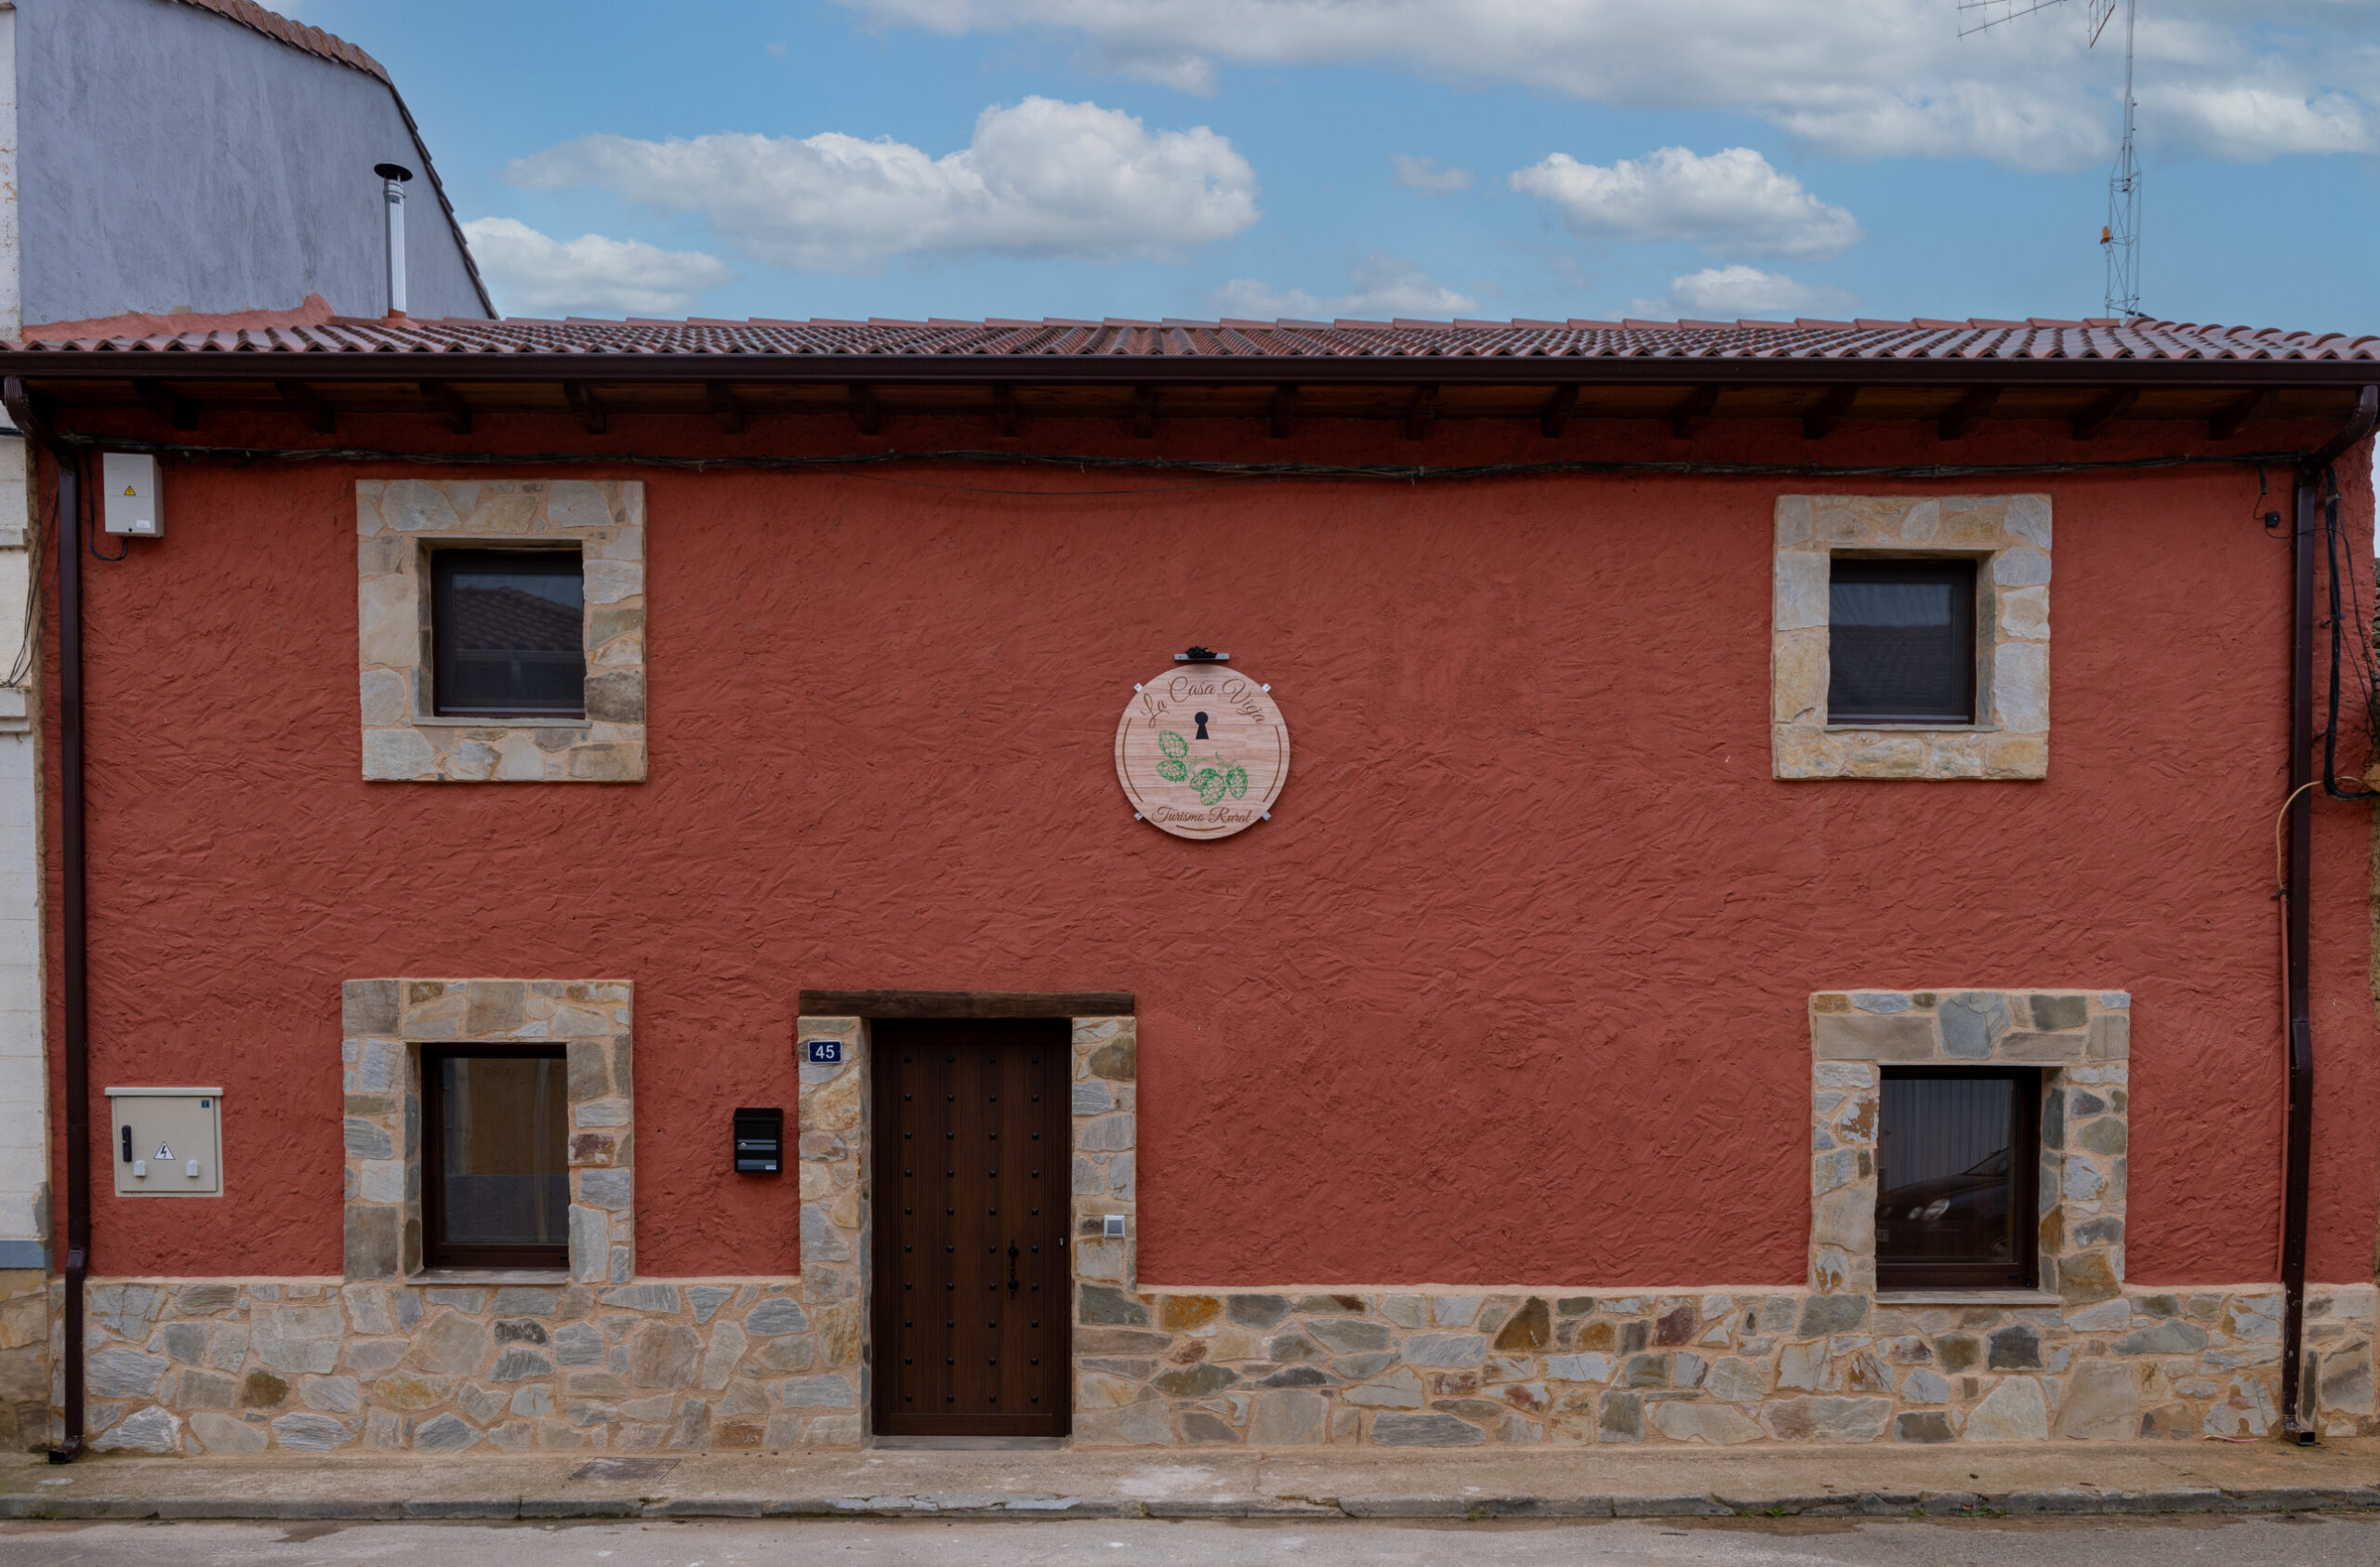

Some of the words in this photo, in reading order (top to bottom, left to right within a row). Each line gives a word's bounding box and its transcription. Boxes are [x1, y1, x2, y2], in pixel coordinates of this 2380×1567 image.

[1141, 693, 1170, 729] La
[1168, 676, 1217, 704] Casa
[1222, 678, 1265, 723] Vieja
[1151, 806, 1205, 823] Turismo
[1208, 807, 1252, 823] Rural
[815, 1045, 835, 1059] 45
